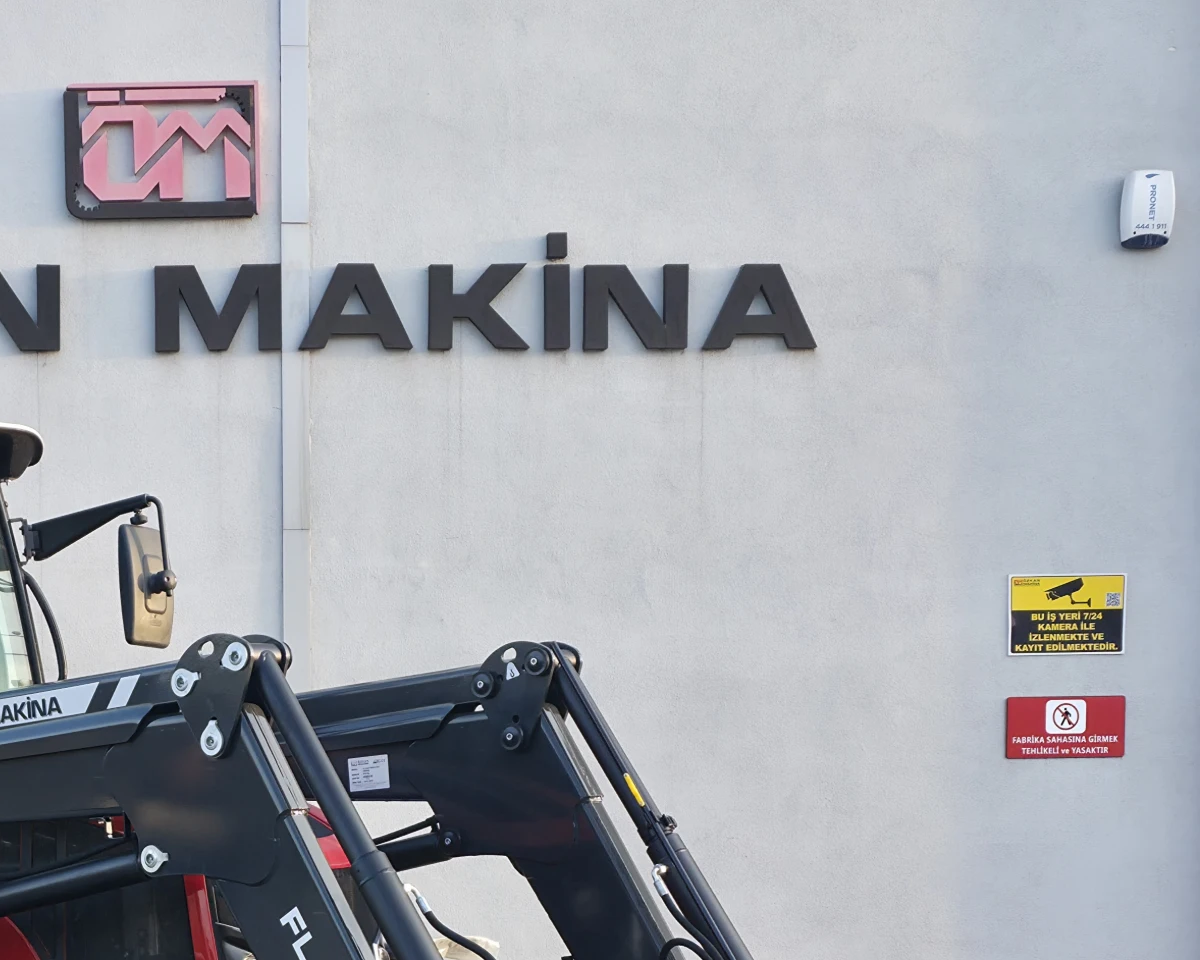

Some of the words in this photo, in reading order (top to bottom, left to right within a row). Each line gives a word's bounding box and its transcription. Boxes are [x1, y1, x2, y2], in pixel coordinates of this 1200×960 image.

[1148, 184, 1157, 221] PRONET
[154, 231, 817, 352] MAKİNA
[1031, 613, 1044, 621] BU
[1047, 612, 1056, 622] İŞ
[1059, 611, 1081, 620] YERİ
[1083, 612, 1103, 620] 7/24
[1038, 623, 1078, 631] KAMERA
[1080, 621, 1096, 630] İLE
[1029, 632, 1089, 641] İZLENMEKTE
[1015, 644, 1043, 652] KAYIT
[1045, 641, 1119, 651] EDİLMEKTEDİR.
[1012, 735, 1045, 744] FABRİKA
[1046, 735, 1087, 743] SAHASINA
[1088, 734, 1118, 743] GİRMEK
[1021, 746, 1060, 755] TEHLİKELİ
[1071, 746, 1109, 754] YASAKTIR
